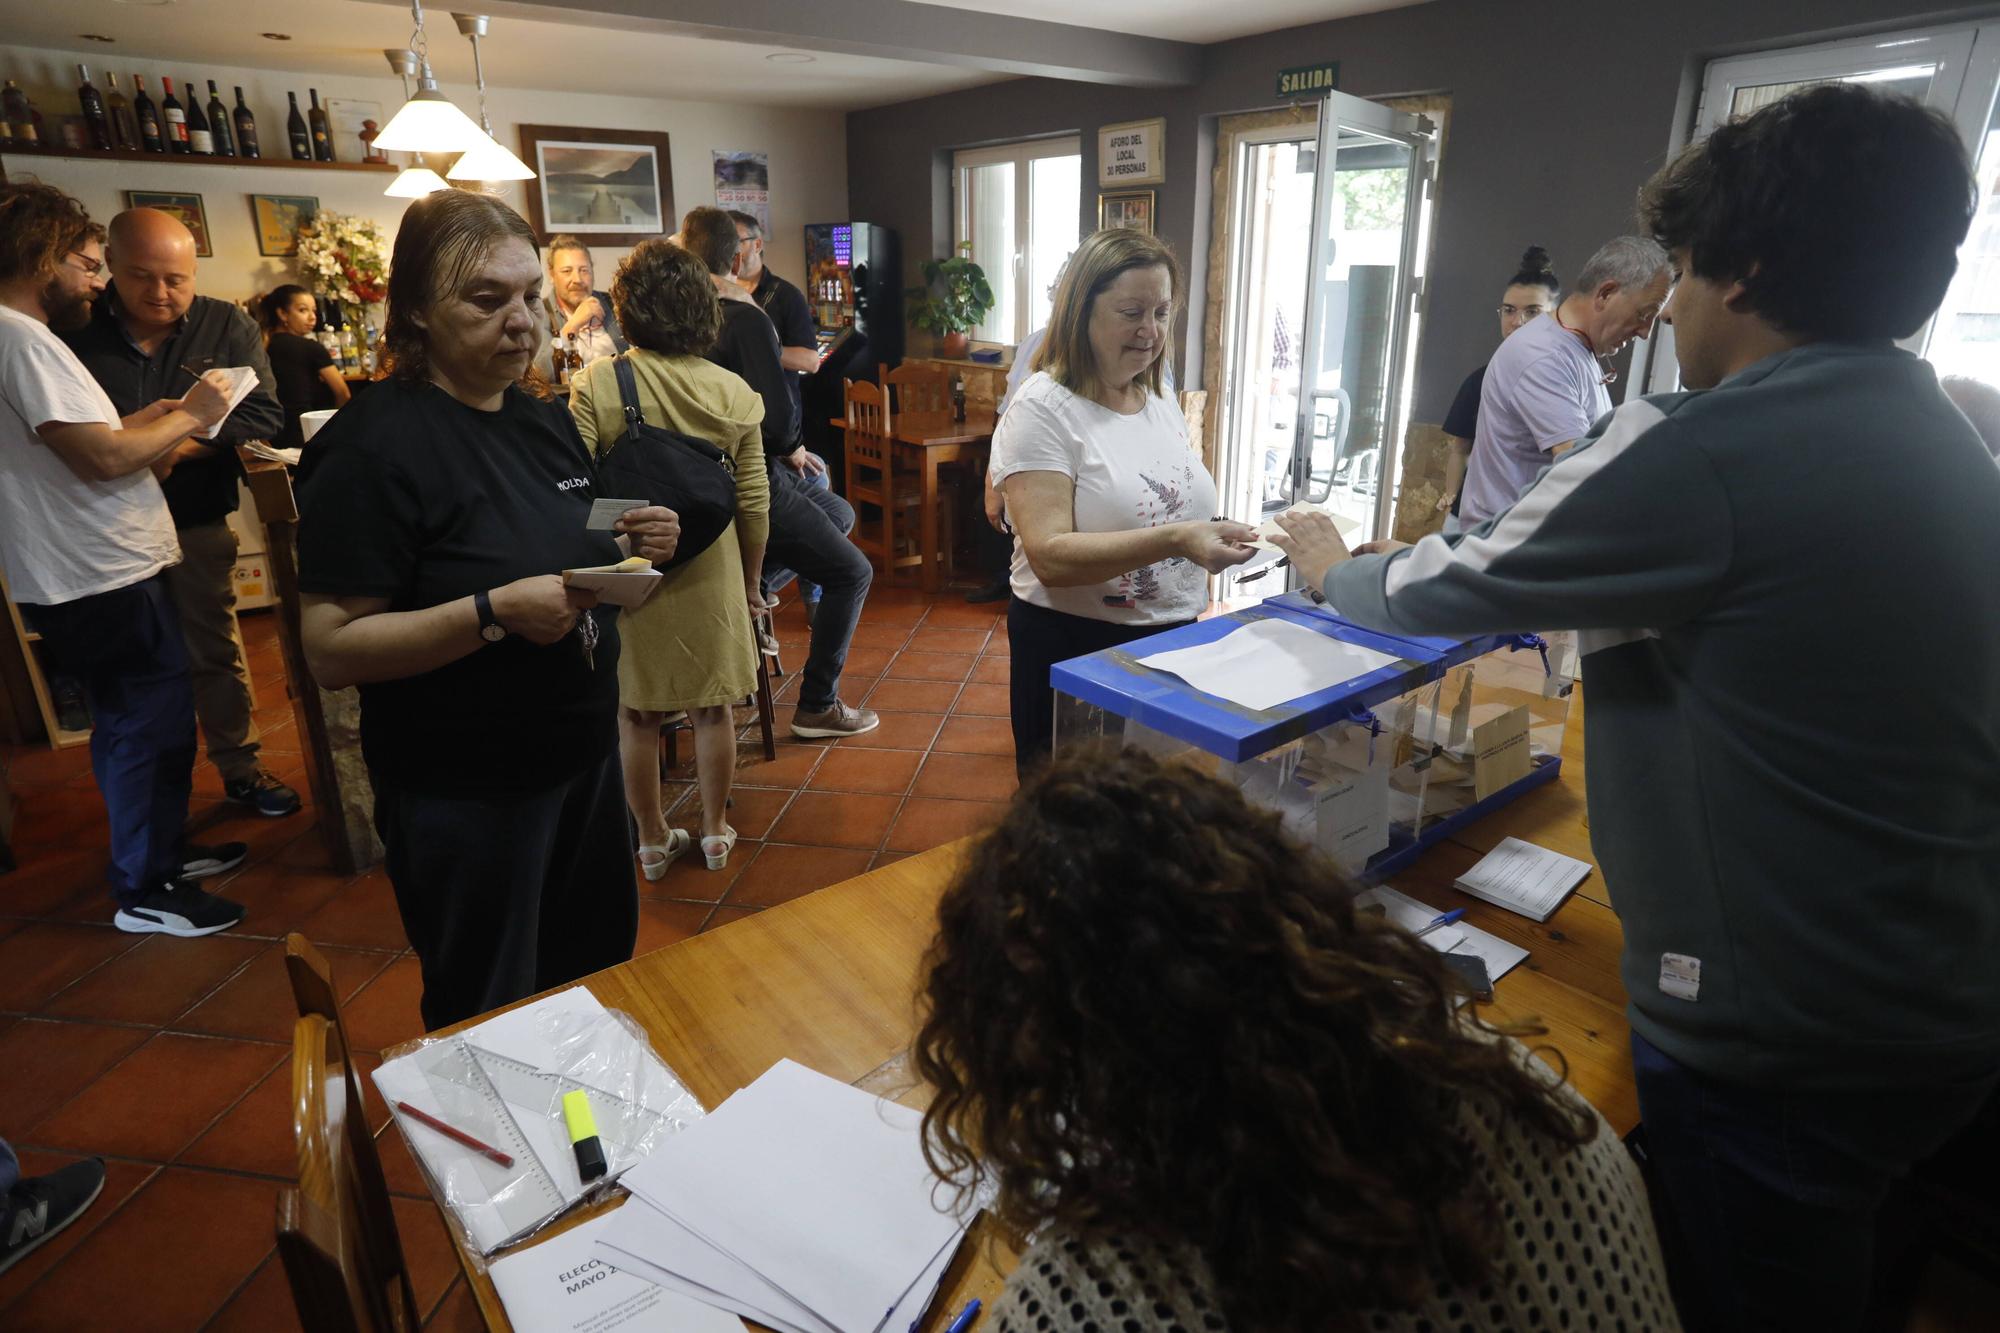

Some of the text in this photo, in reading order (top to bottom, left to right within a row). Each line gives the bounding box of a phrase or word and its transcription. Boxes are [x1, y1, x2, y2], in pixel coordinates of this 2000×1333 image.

[1281, 68, 1333, 93] SALIDA
[1110, 134, 1143, 148] AFORO DEL
[1116, 149, 1136, 161] LOCAL
[1115, 162, 1146, 175] PERSONAS
[566, 1271, 606, 1295] MAYO
